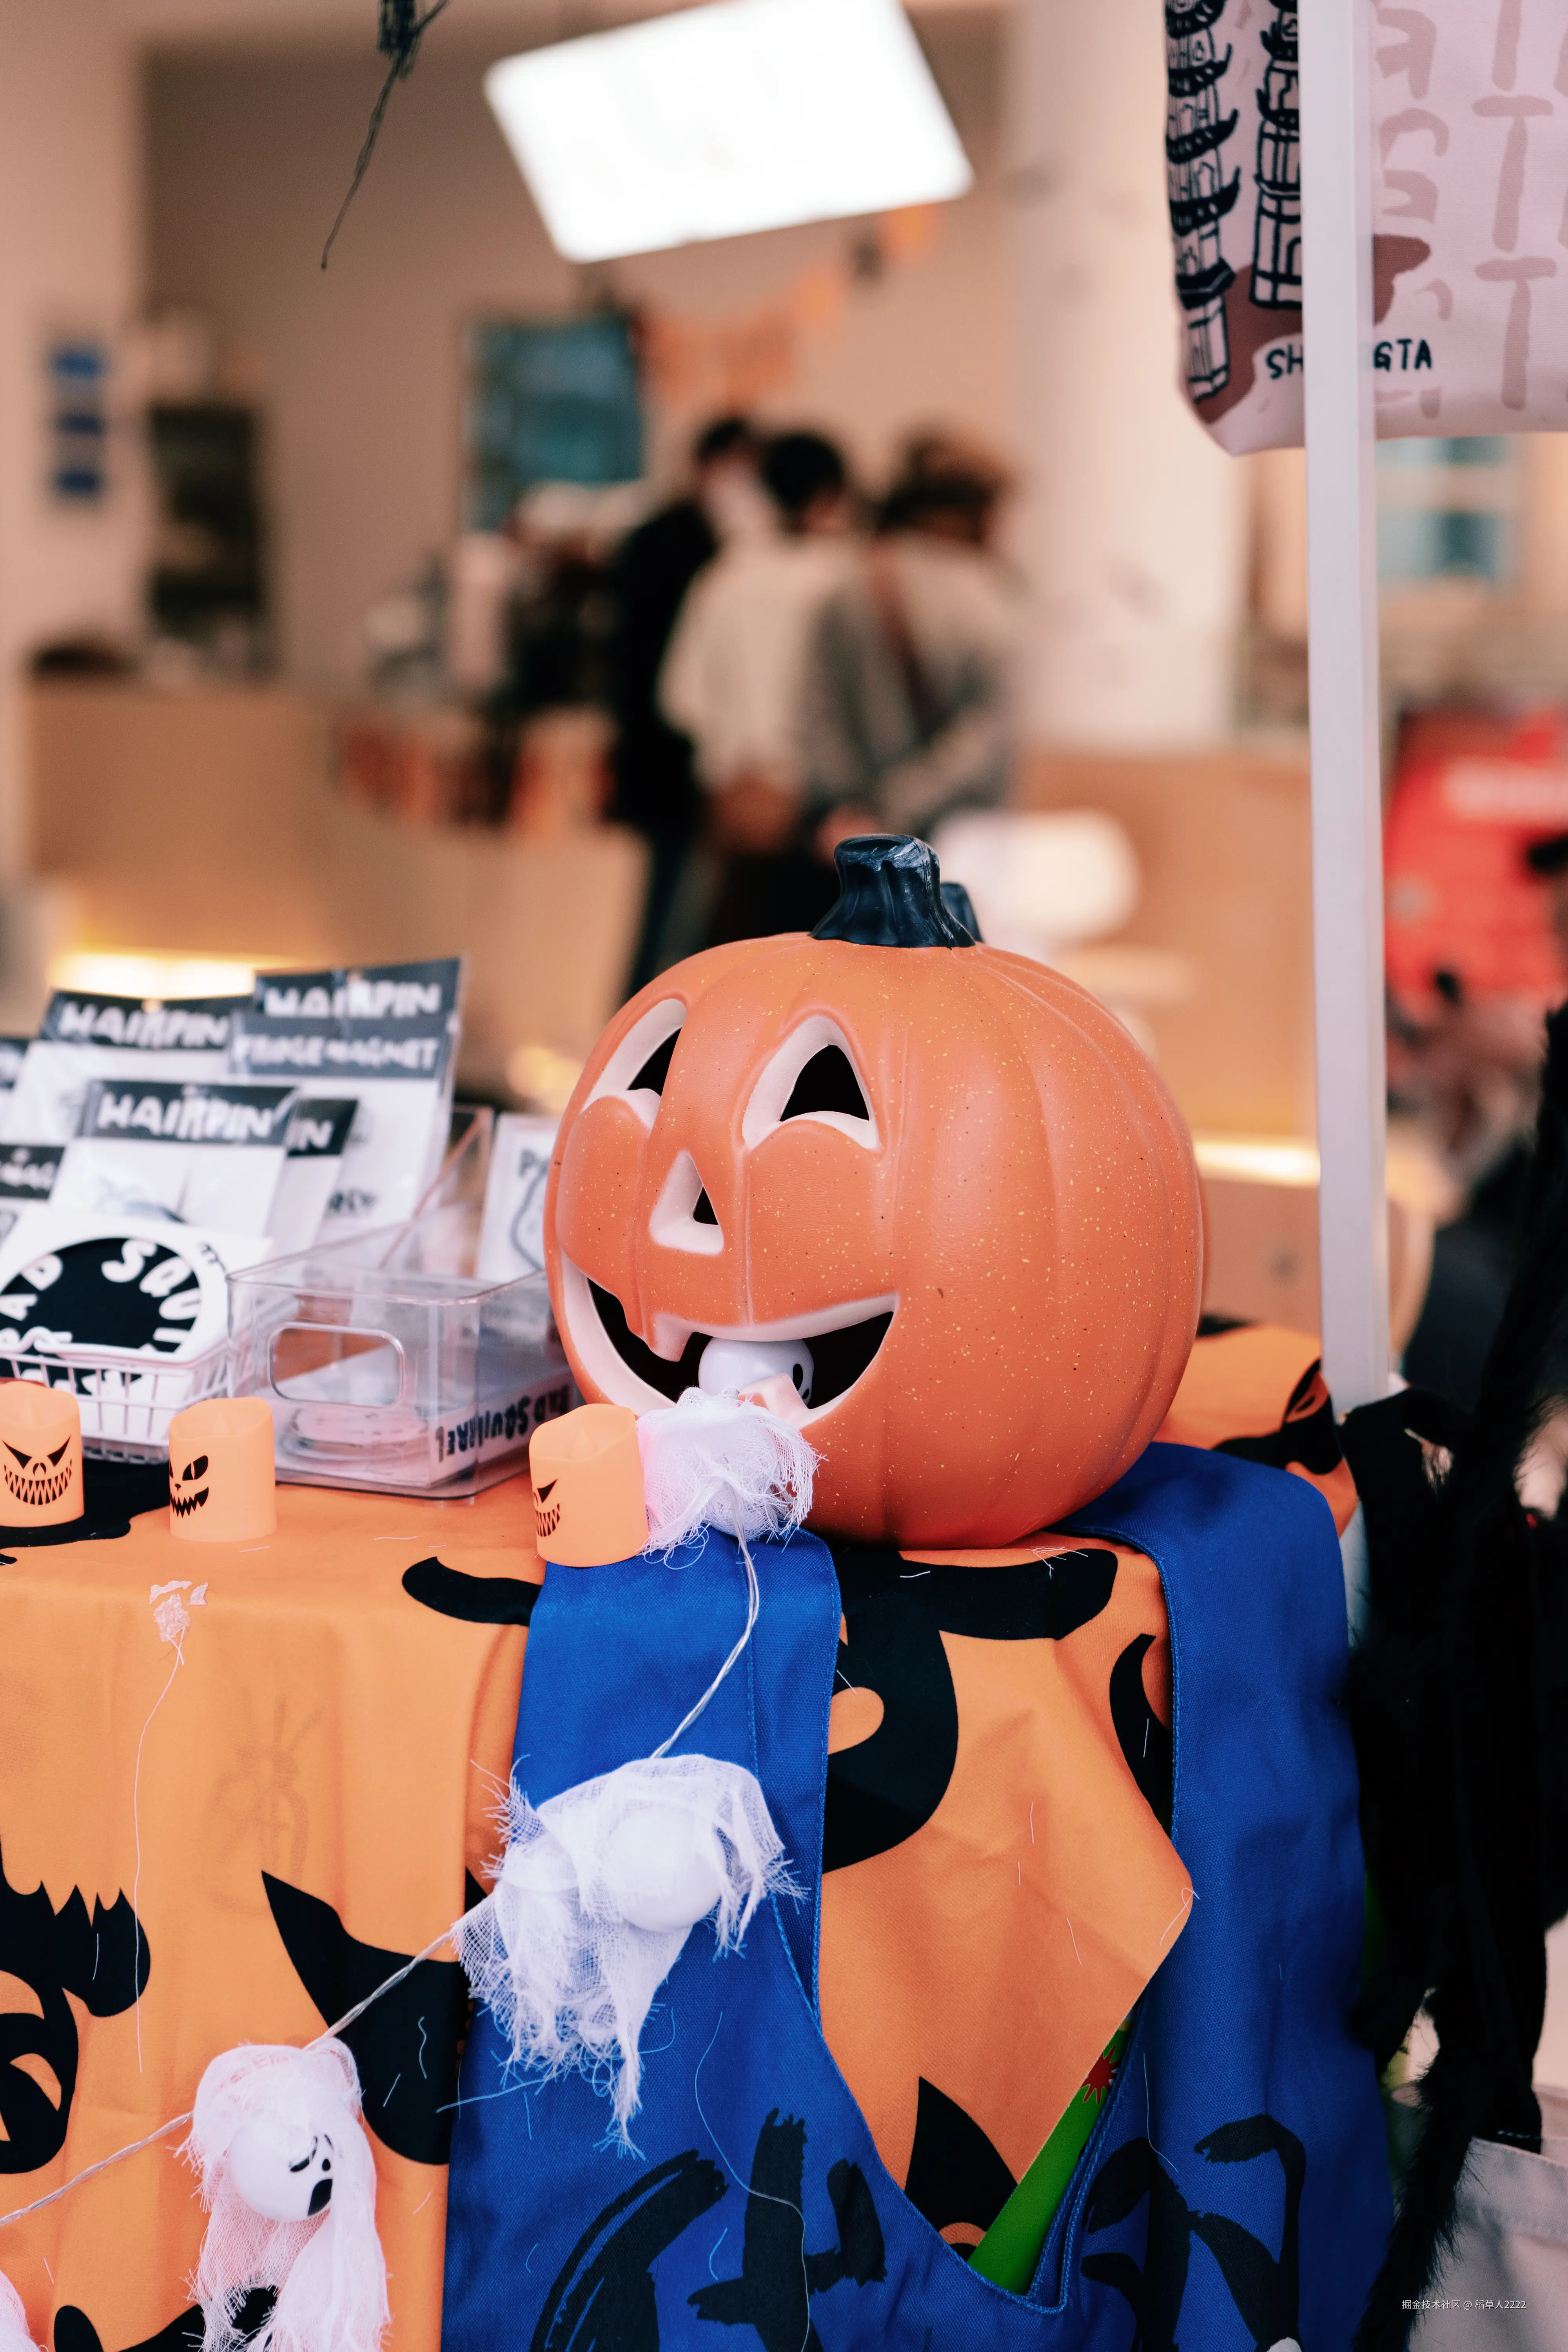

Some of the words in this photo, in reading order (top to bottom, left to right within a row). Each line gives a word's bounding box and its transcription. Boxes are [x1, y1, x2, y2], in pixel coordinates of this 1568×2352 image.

[1266, 339, 1432, 379] SHGTA
[263, 978, 442, 1018] HAIRPIN
[57, 1001, 230, 1048] HAIRPIN
[97, 1090, 274, 1139] HAIRPIN
